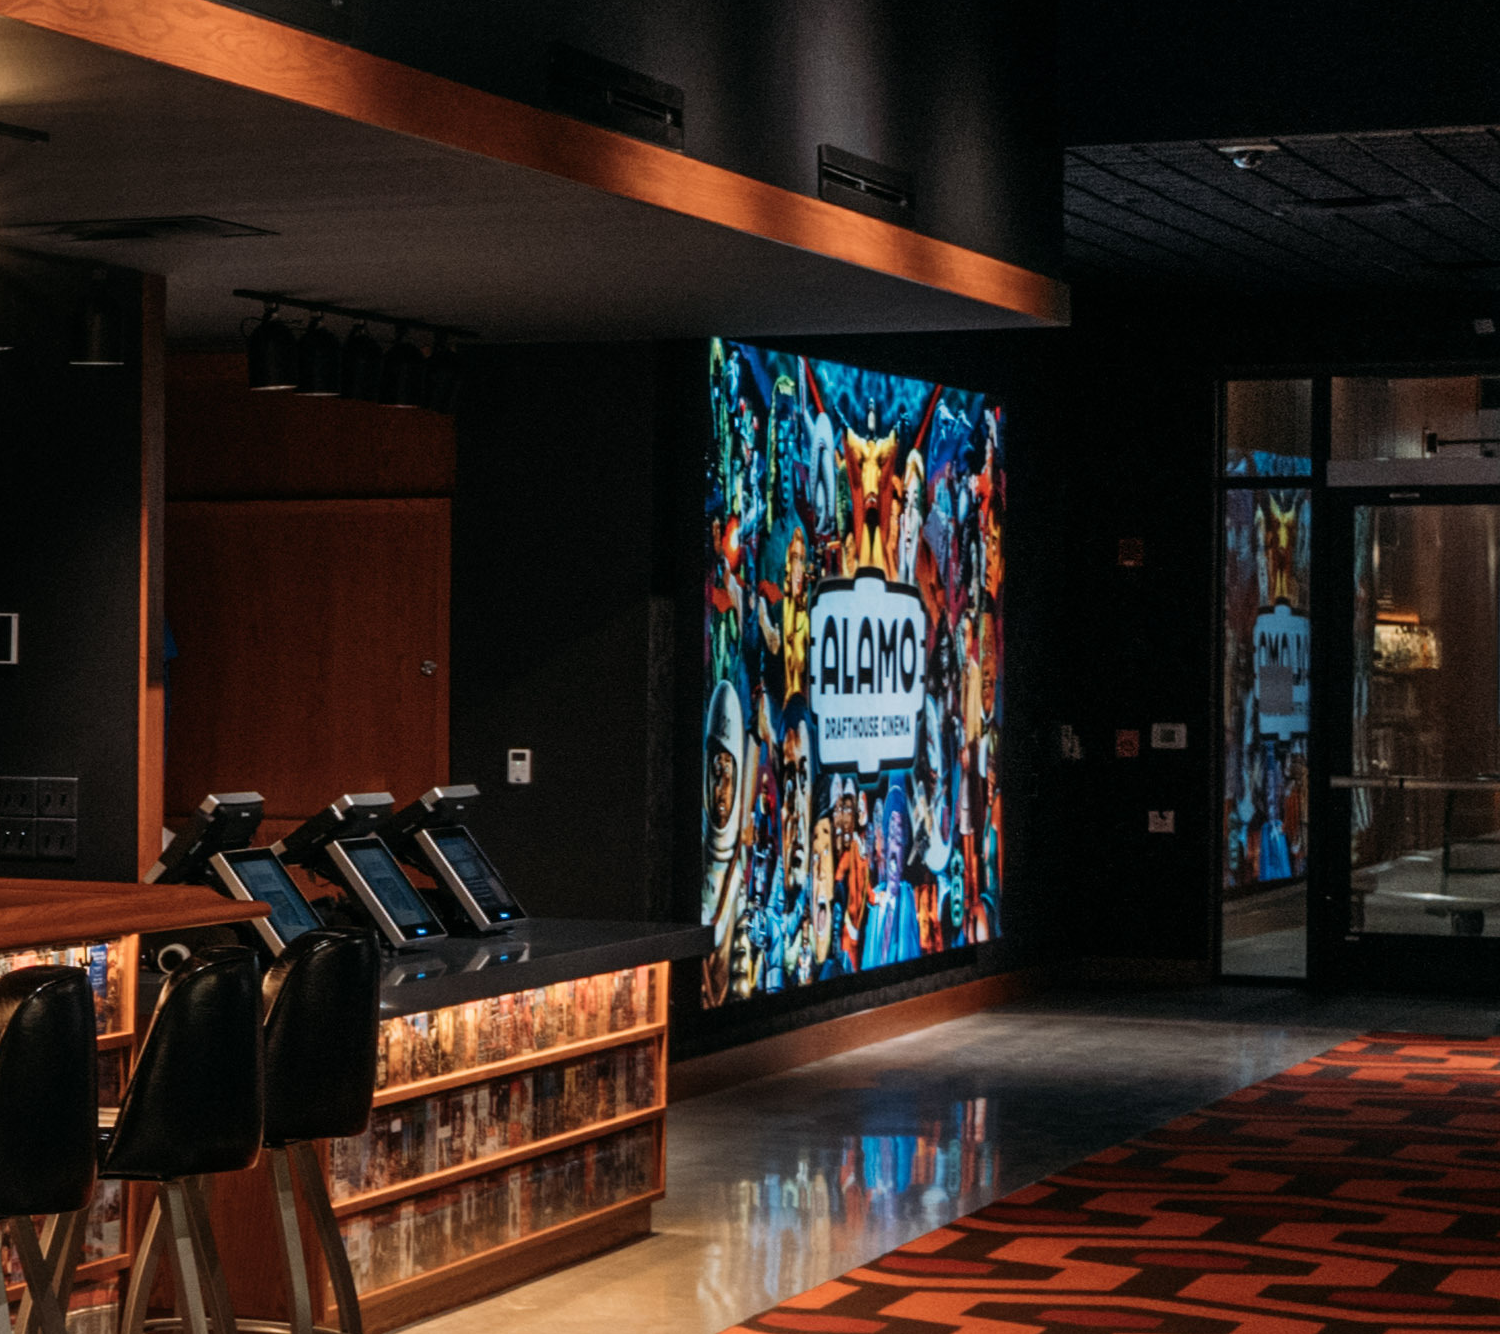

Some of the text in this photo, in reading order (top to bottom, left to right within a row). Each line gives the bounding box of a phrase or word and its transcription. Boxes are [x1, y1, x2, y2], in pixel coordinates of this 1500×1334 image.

[820, 614, 917, 695] ALAMO
[825, 714, 910, 740] DRAFTHOUSE CINEMA
